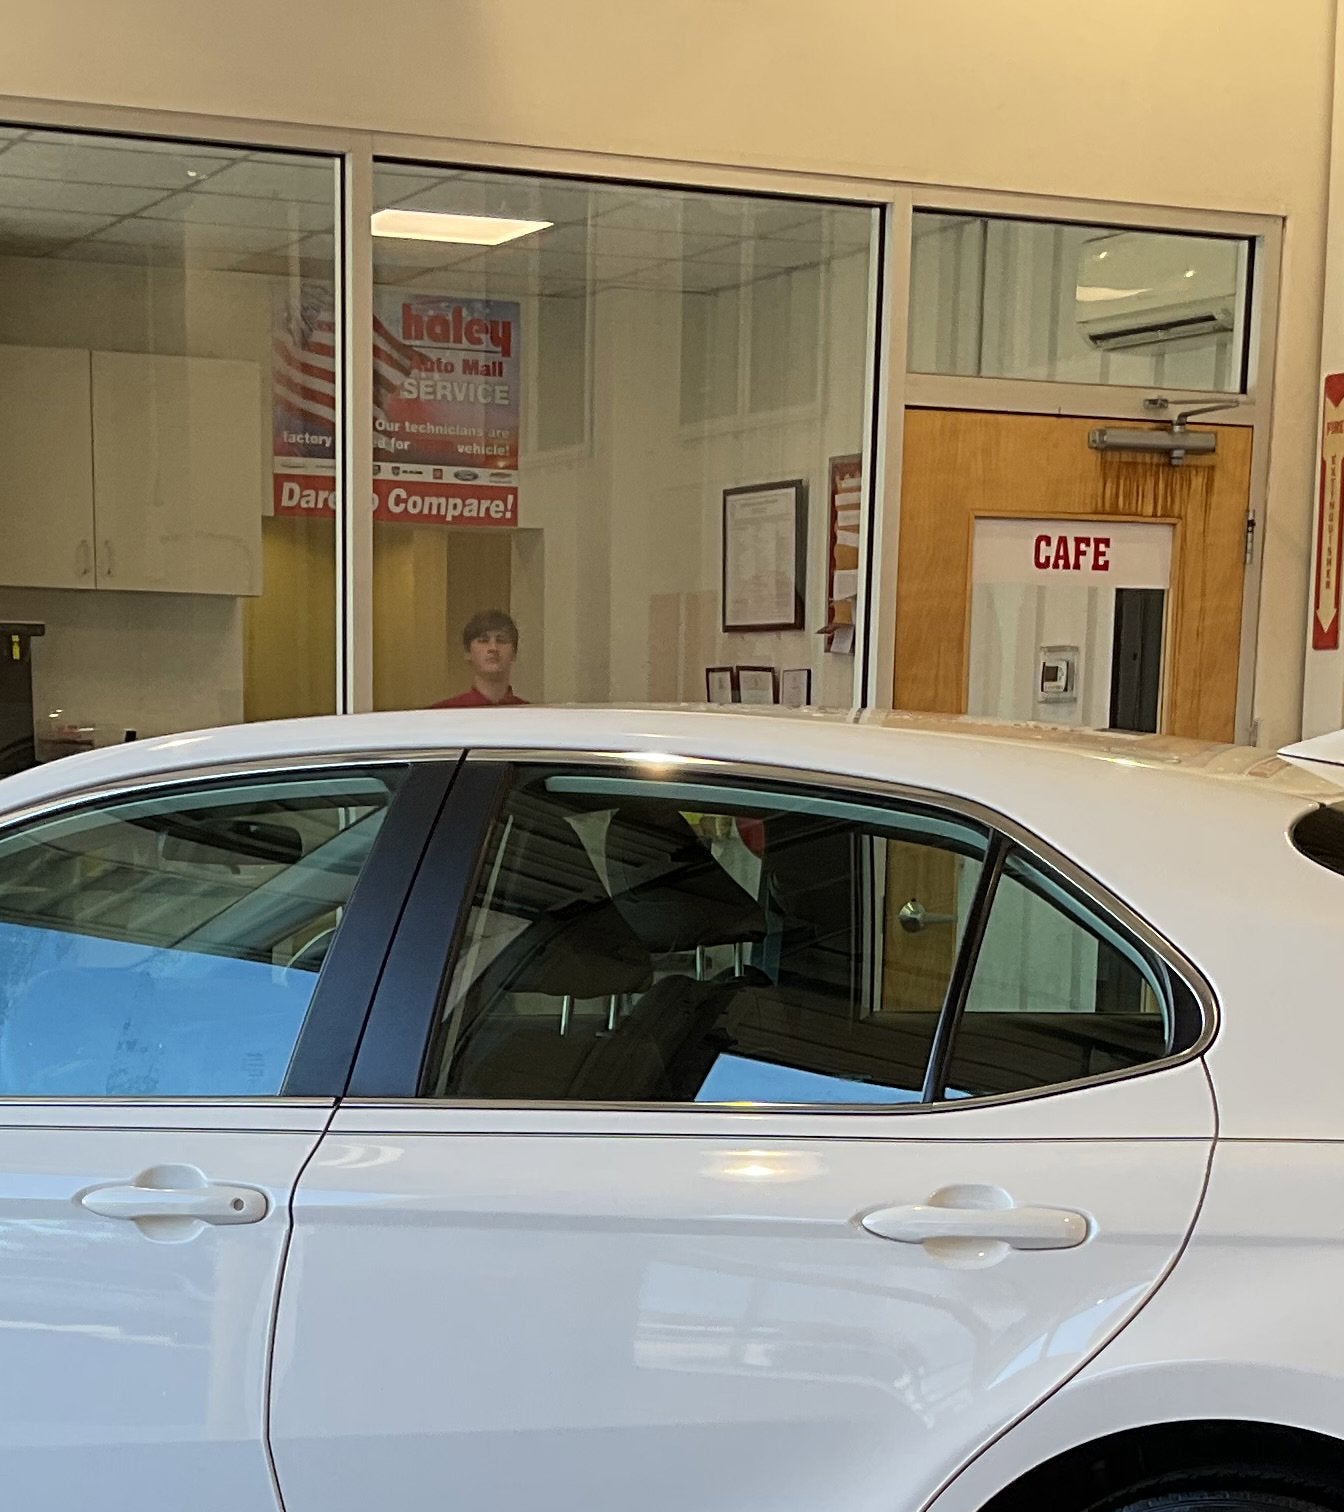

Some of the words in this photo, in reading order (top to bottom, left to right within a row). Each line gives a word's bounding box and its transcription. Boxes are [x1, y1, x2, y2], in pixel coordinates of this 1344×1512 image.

[402, 303, 511, 358] haley
[410, 357, 455, 374] Auto
[462, 358, 503, 377] Mall
[401, 378, 509, 405] SERVICE
[375, 419, 401, 432] Our
[404, 421, 484, 437] technicians
[487, 429, 510, 439] are
[1327, 420, 1344, 434] FIRE
[283, 430, 333, 448] factory
[390, 438, 411, 453] for
[457, 442, 510, 456] vehicle!
[387, 487, 514, 521] Compare!
[1034, 534, 1111, 571] CAFE
